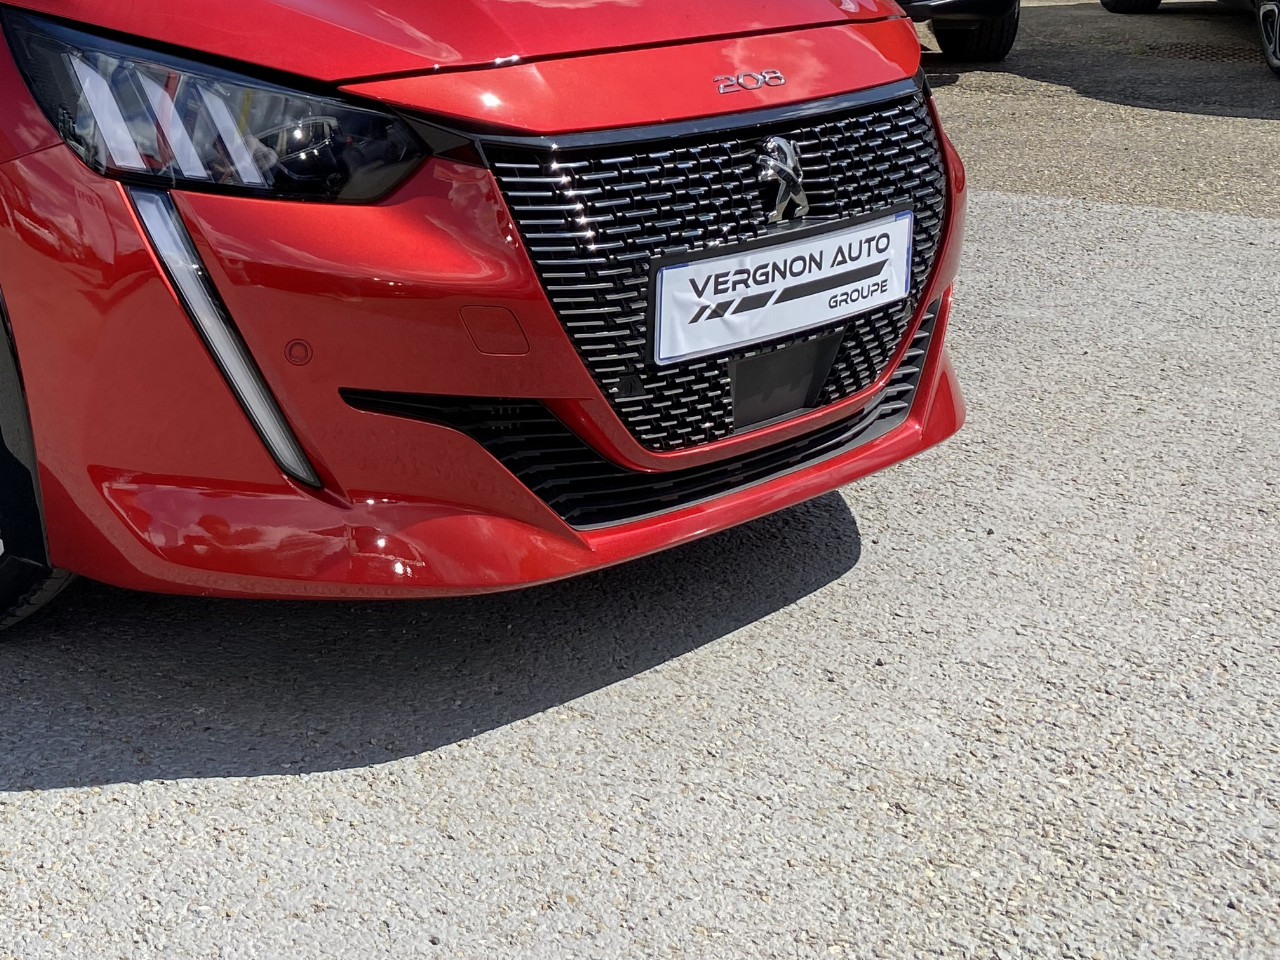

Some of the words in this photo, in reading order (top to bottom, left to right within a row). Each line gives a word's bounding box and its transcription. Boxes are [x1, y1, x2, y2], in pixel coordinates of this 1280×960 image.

[712, 68, 787, 94] 208
[688, 250, 824, 299] VERGNON
[829, 231, 891, 269] AUTO
[828, 278, 889, 310] GROUPE
